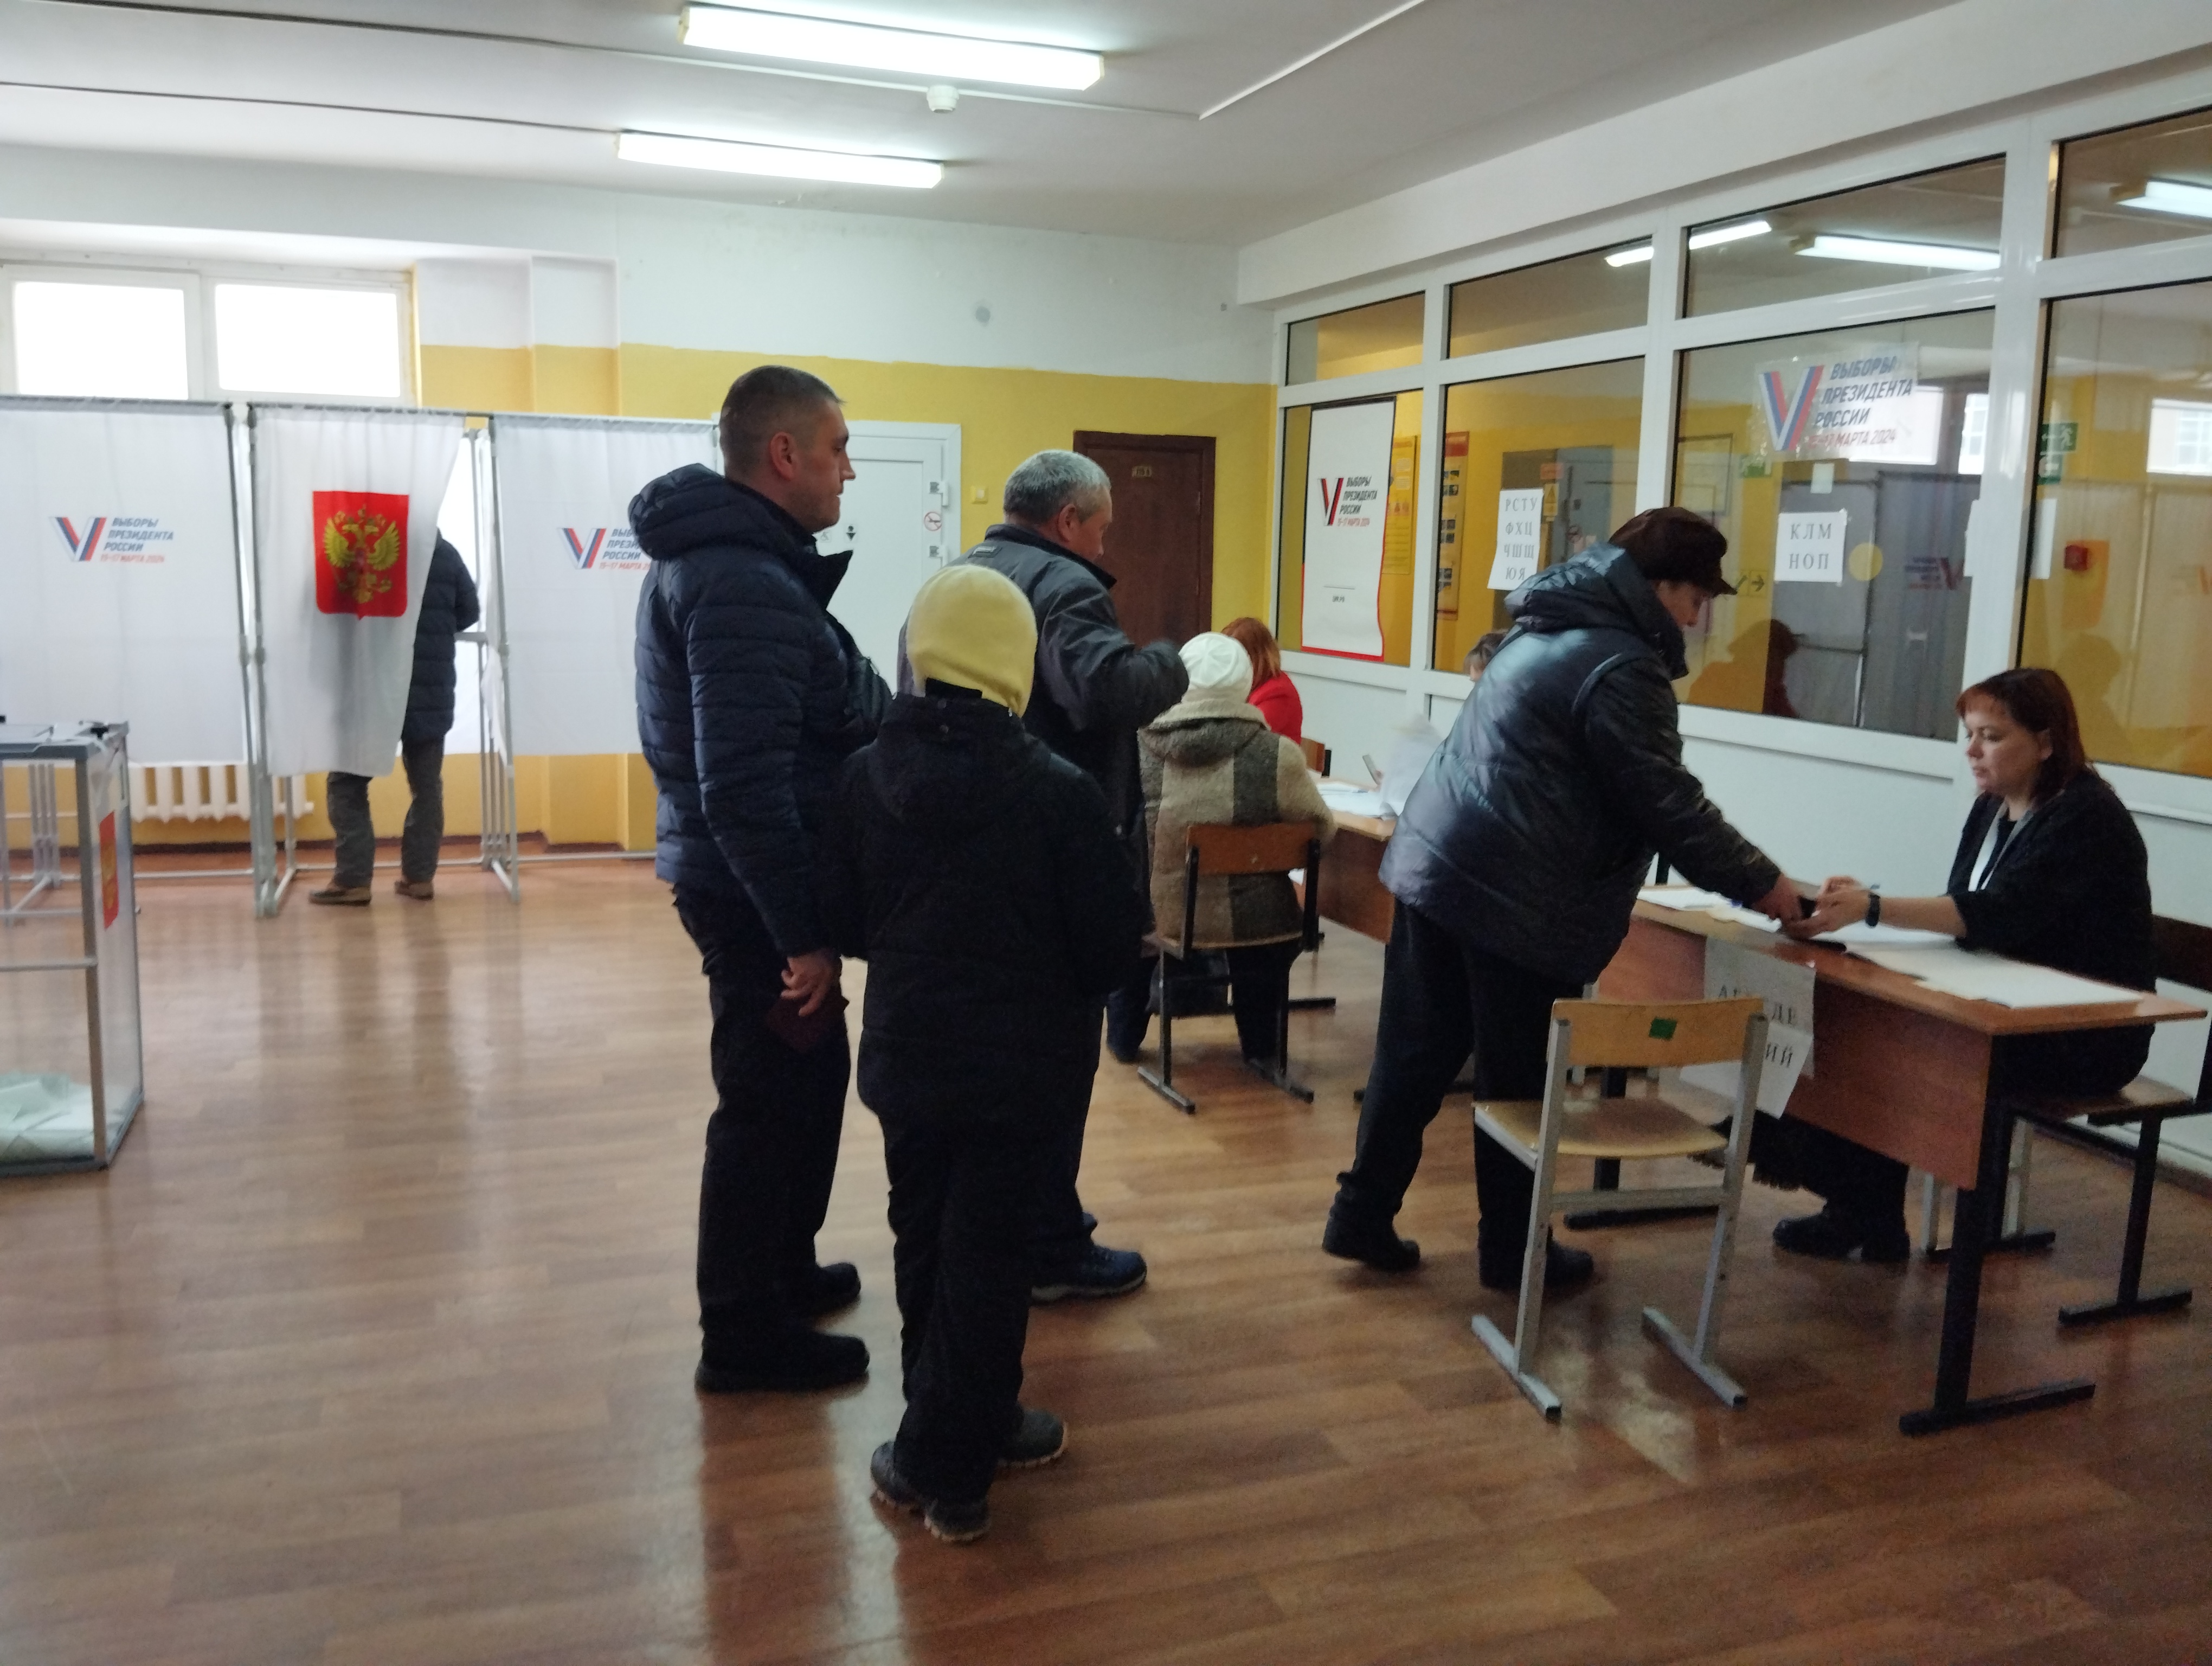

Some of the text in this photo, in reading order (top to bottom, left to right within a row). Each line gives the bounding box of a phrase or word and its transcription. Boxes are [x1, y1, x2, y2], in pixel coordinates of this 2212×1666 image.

[1830, 356, 1897, 381] ВЫБОРЫ
[1821, 379, 1913, 405] ПРЕЗИДЕНТА
[1814, 408, 1871, 428] РОССИИ
[1836, 431, 1869, 447] МАРТА
[1870, 429, 1896, 445] 2024
[1346, 476, 1372, 488] ВЫБОРЫ
[1343, 490, 1378, 501] ПРЕЗИДЕНТА
[1339, 504, 1362, 515] РОССИИ
[112, 517, 159, 528] ВЫБОРЫ
[108, 530, 173, 540] ПРЕЗИДЕНТА
[611, 528, 633, 537] ВЫБ
[104, 542, 144, 552] РОССИИ
[606, 539, 641, 549] ПРЕЗИ
[602, 551, 641, 561] РОССИИ
